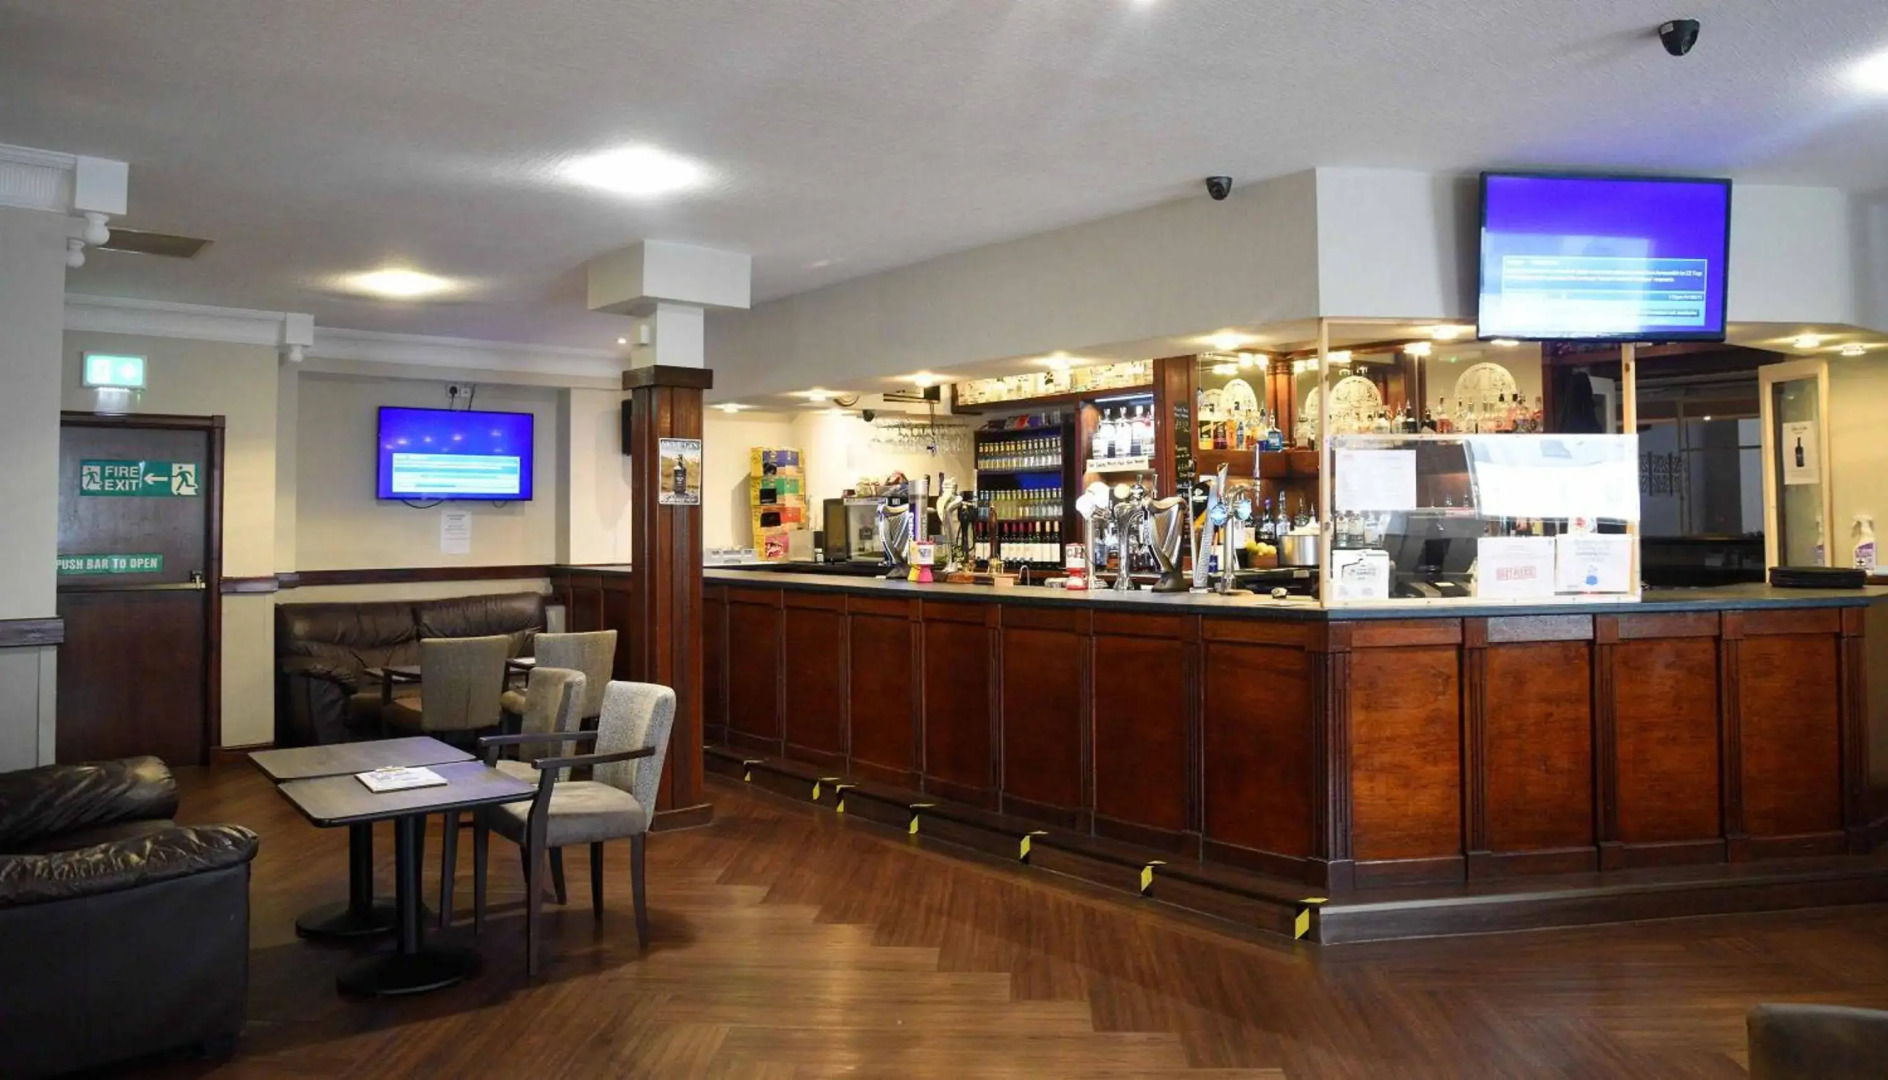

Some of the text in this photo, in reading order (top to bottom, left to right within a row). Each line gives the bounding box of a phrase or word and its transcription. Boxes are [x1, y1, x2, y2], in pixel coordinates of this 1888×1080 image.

[104, 465, 139, 478] FIRE
[104, 479, 140, 491] EXIT
[56, 558, 158, 570] PUSH BAR TO OPEN
